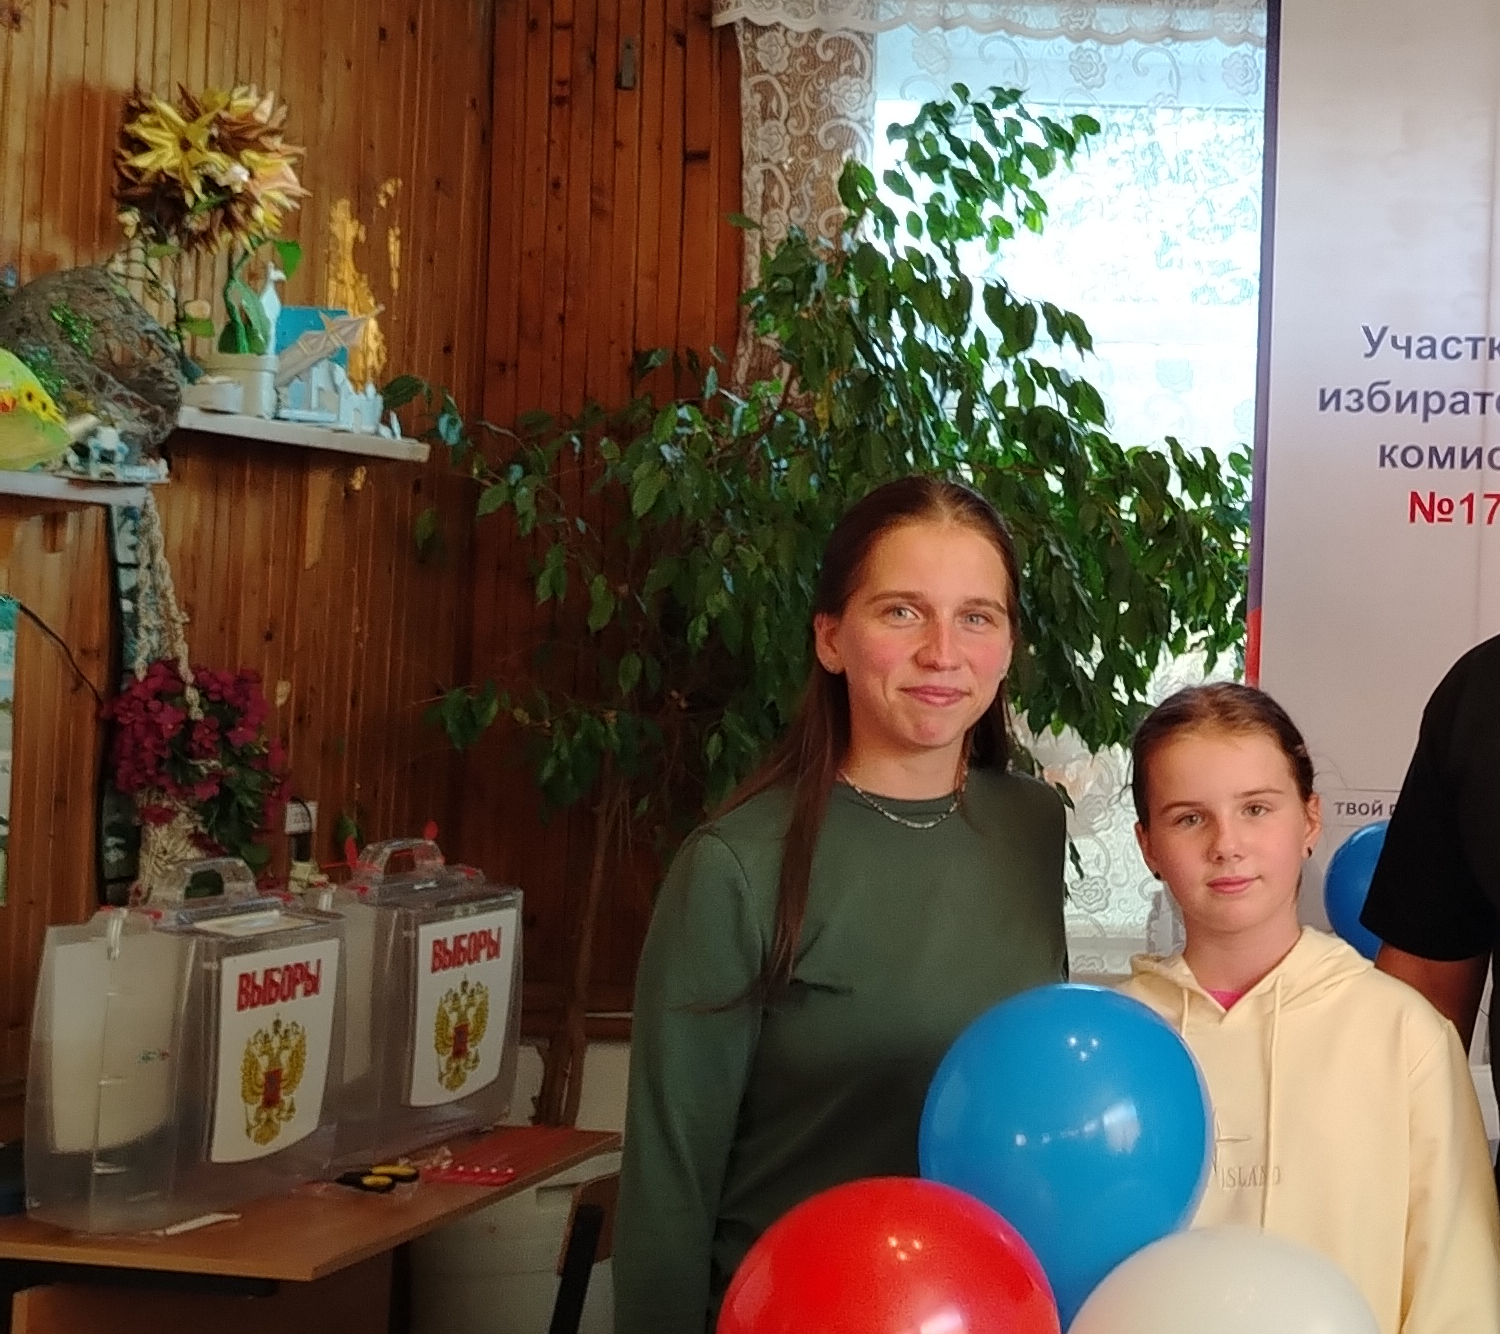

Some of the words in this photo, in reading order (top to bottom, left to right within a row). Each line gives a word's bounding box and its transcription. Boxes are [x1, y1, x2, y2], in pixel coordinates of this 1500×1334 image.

[1333, 799, 1383, 816] ТВОЙ
[430, 926, 503, 975] ВЫБОРЫ
[236, 958, 323, 1013] ВЫБОРЫ
